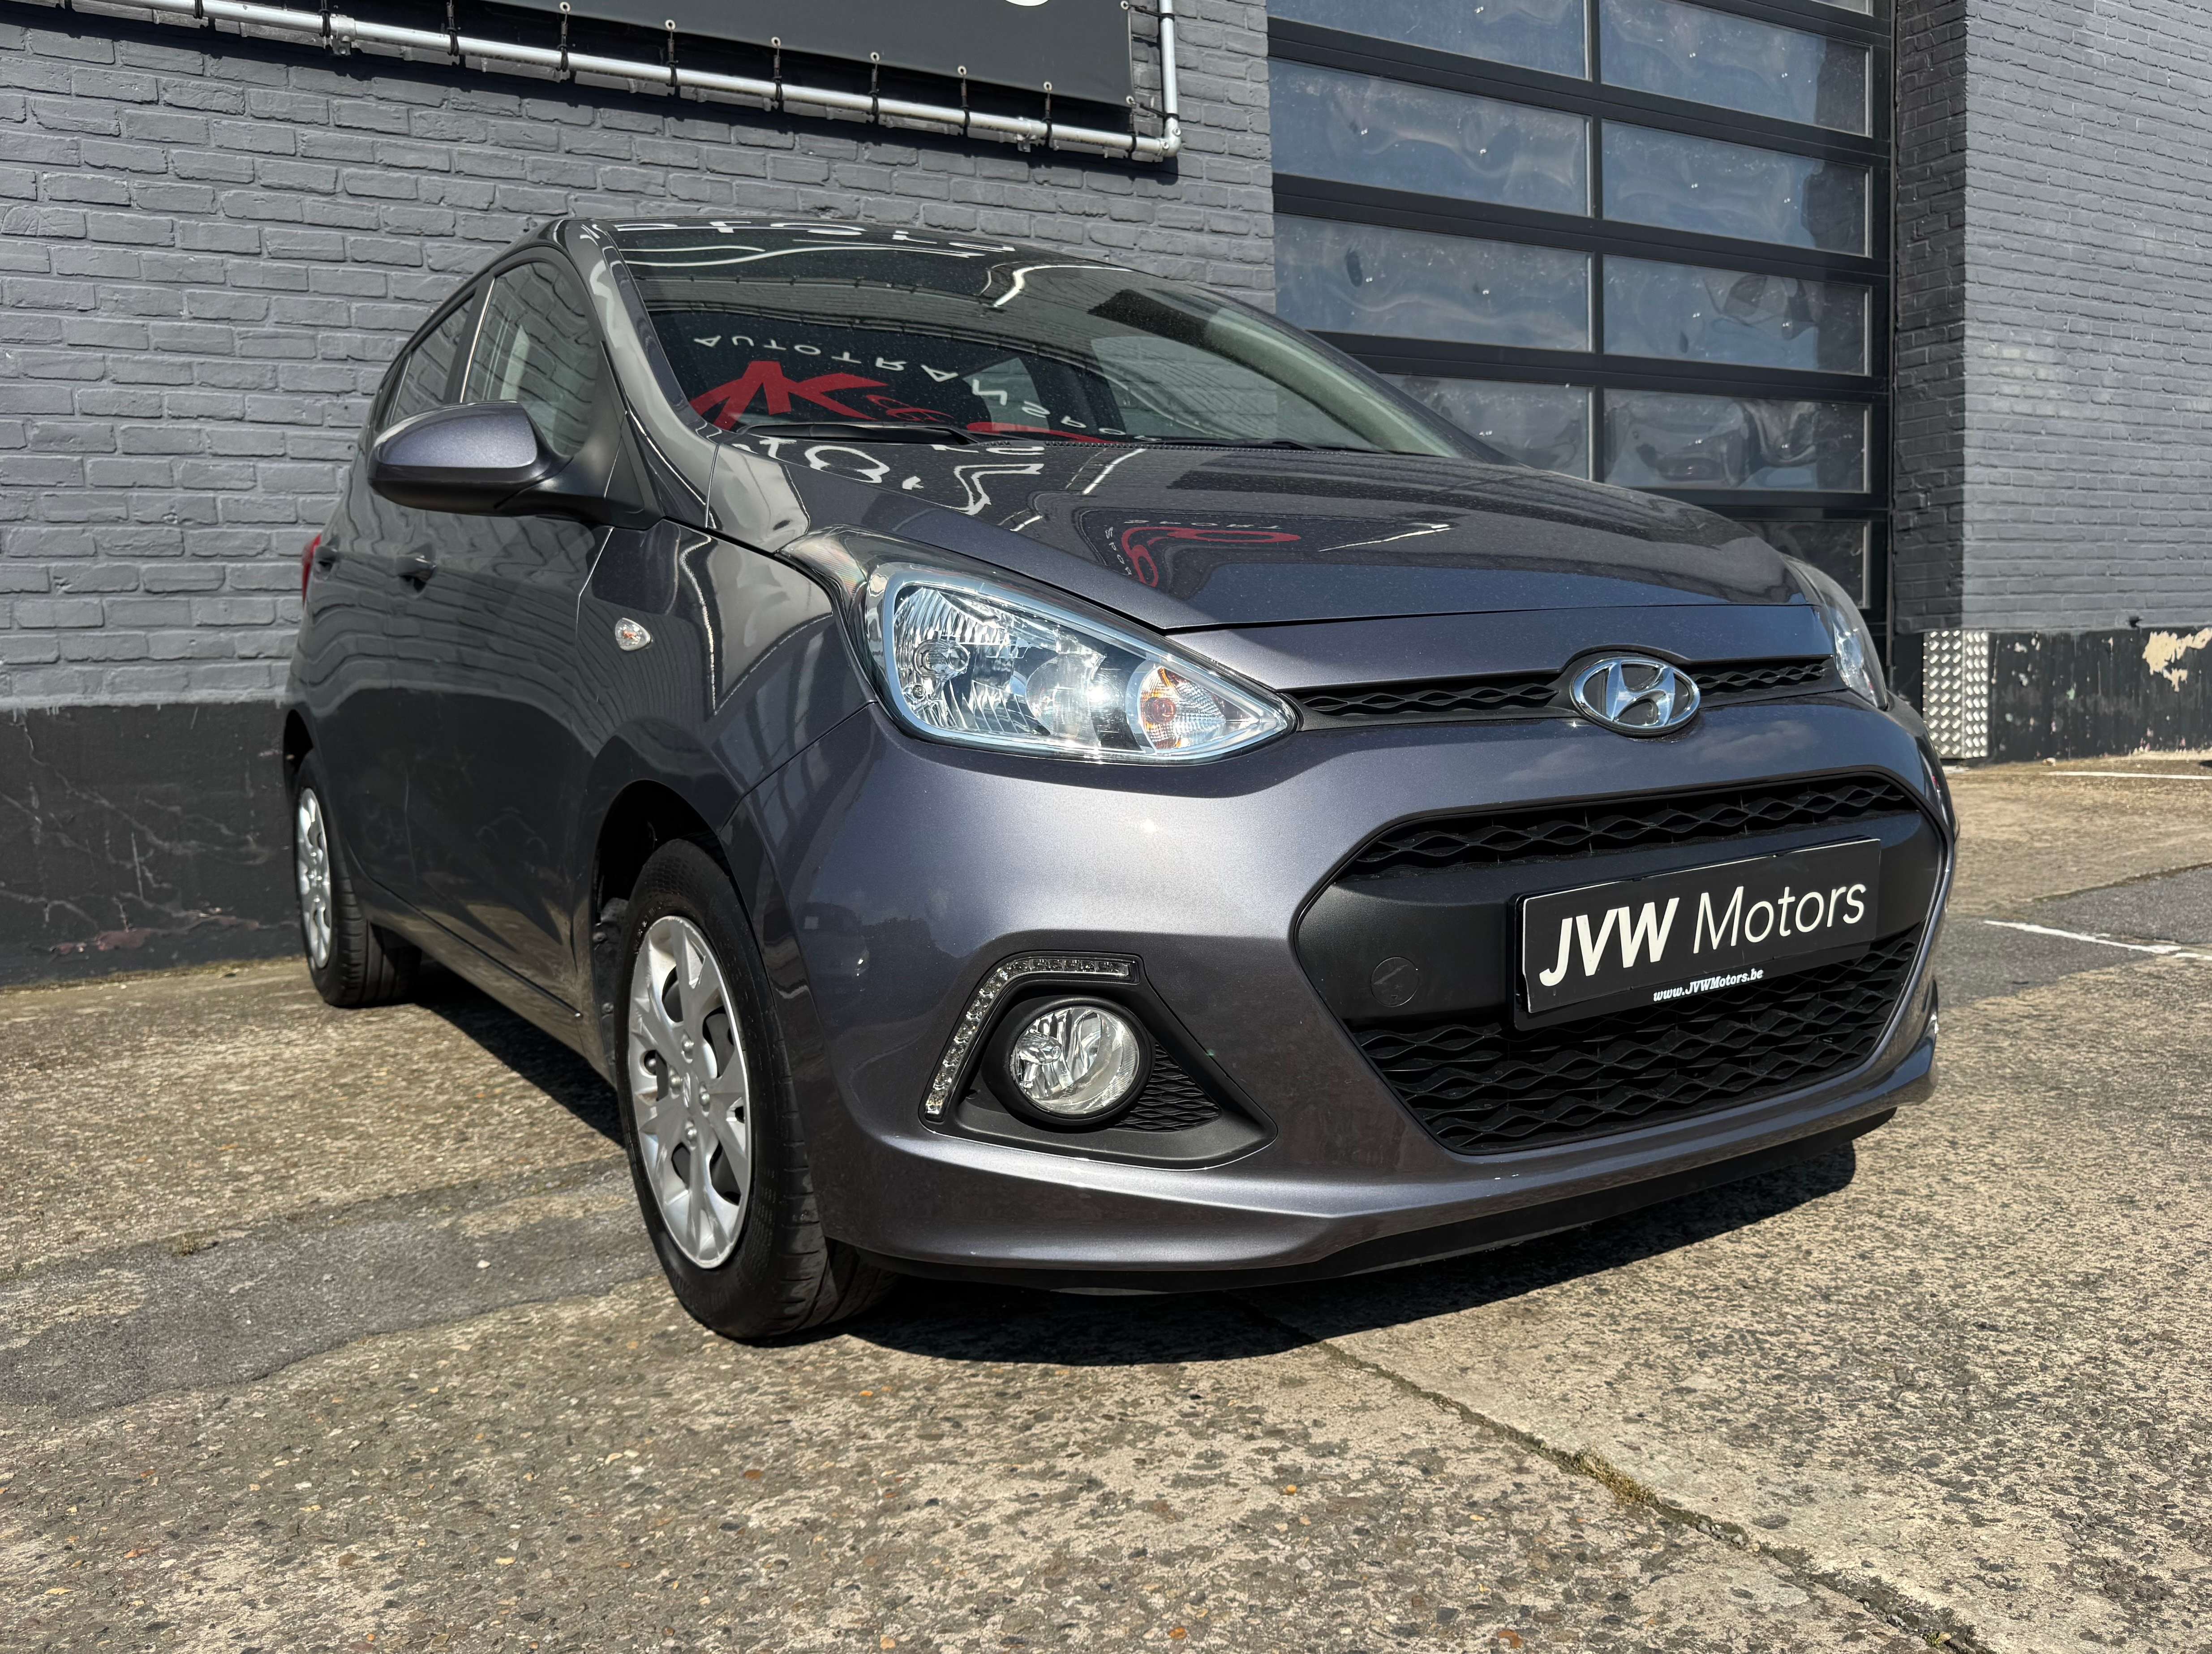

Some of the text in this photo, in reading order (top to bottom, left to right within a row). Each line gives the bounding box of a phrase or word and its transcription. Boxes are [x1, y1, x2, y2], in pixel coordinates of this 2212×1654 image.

[1539, 884, 1866, 986] JVW Motors
[1653, 968, 1764, 1001] www.JVWMotors.be
